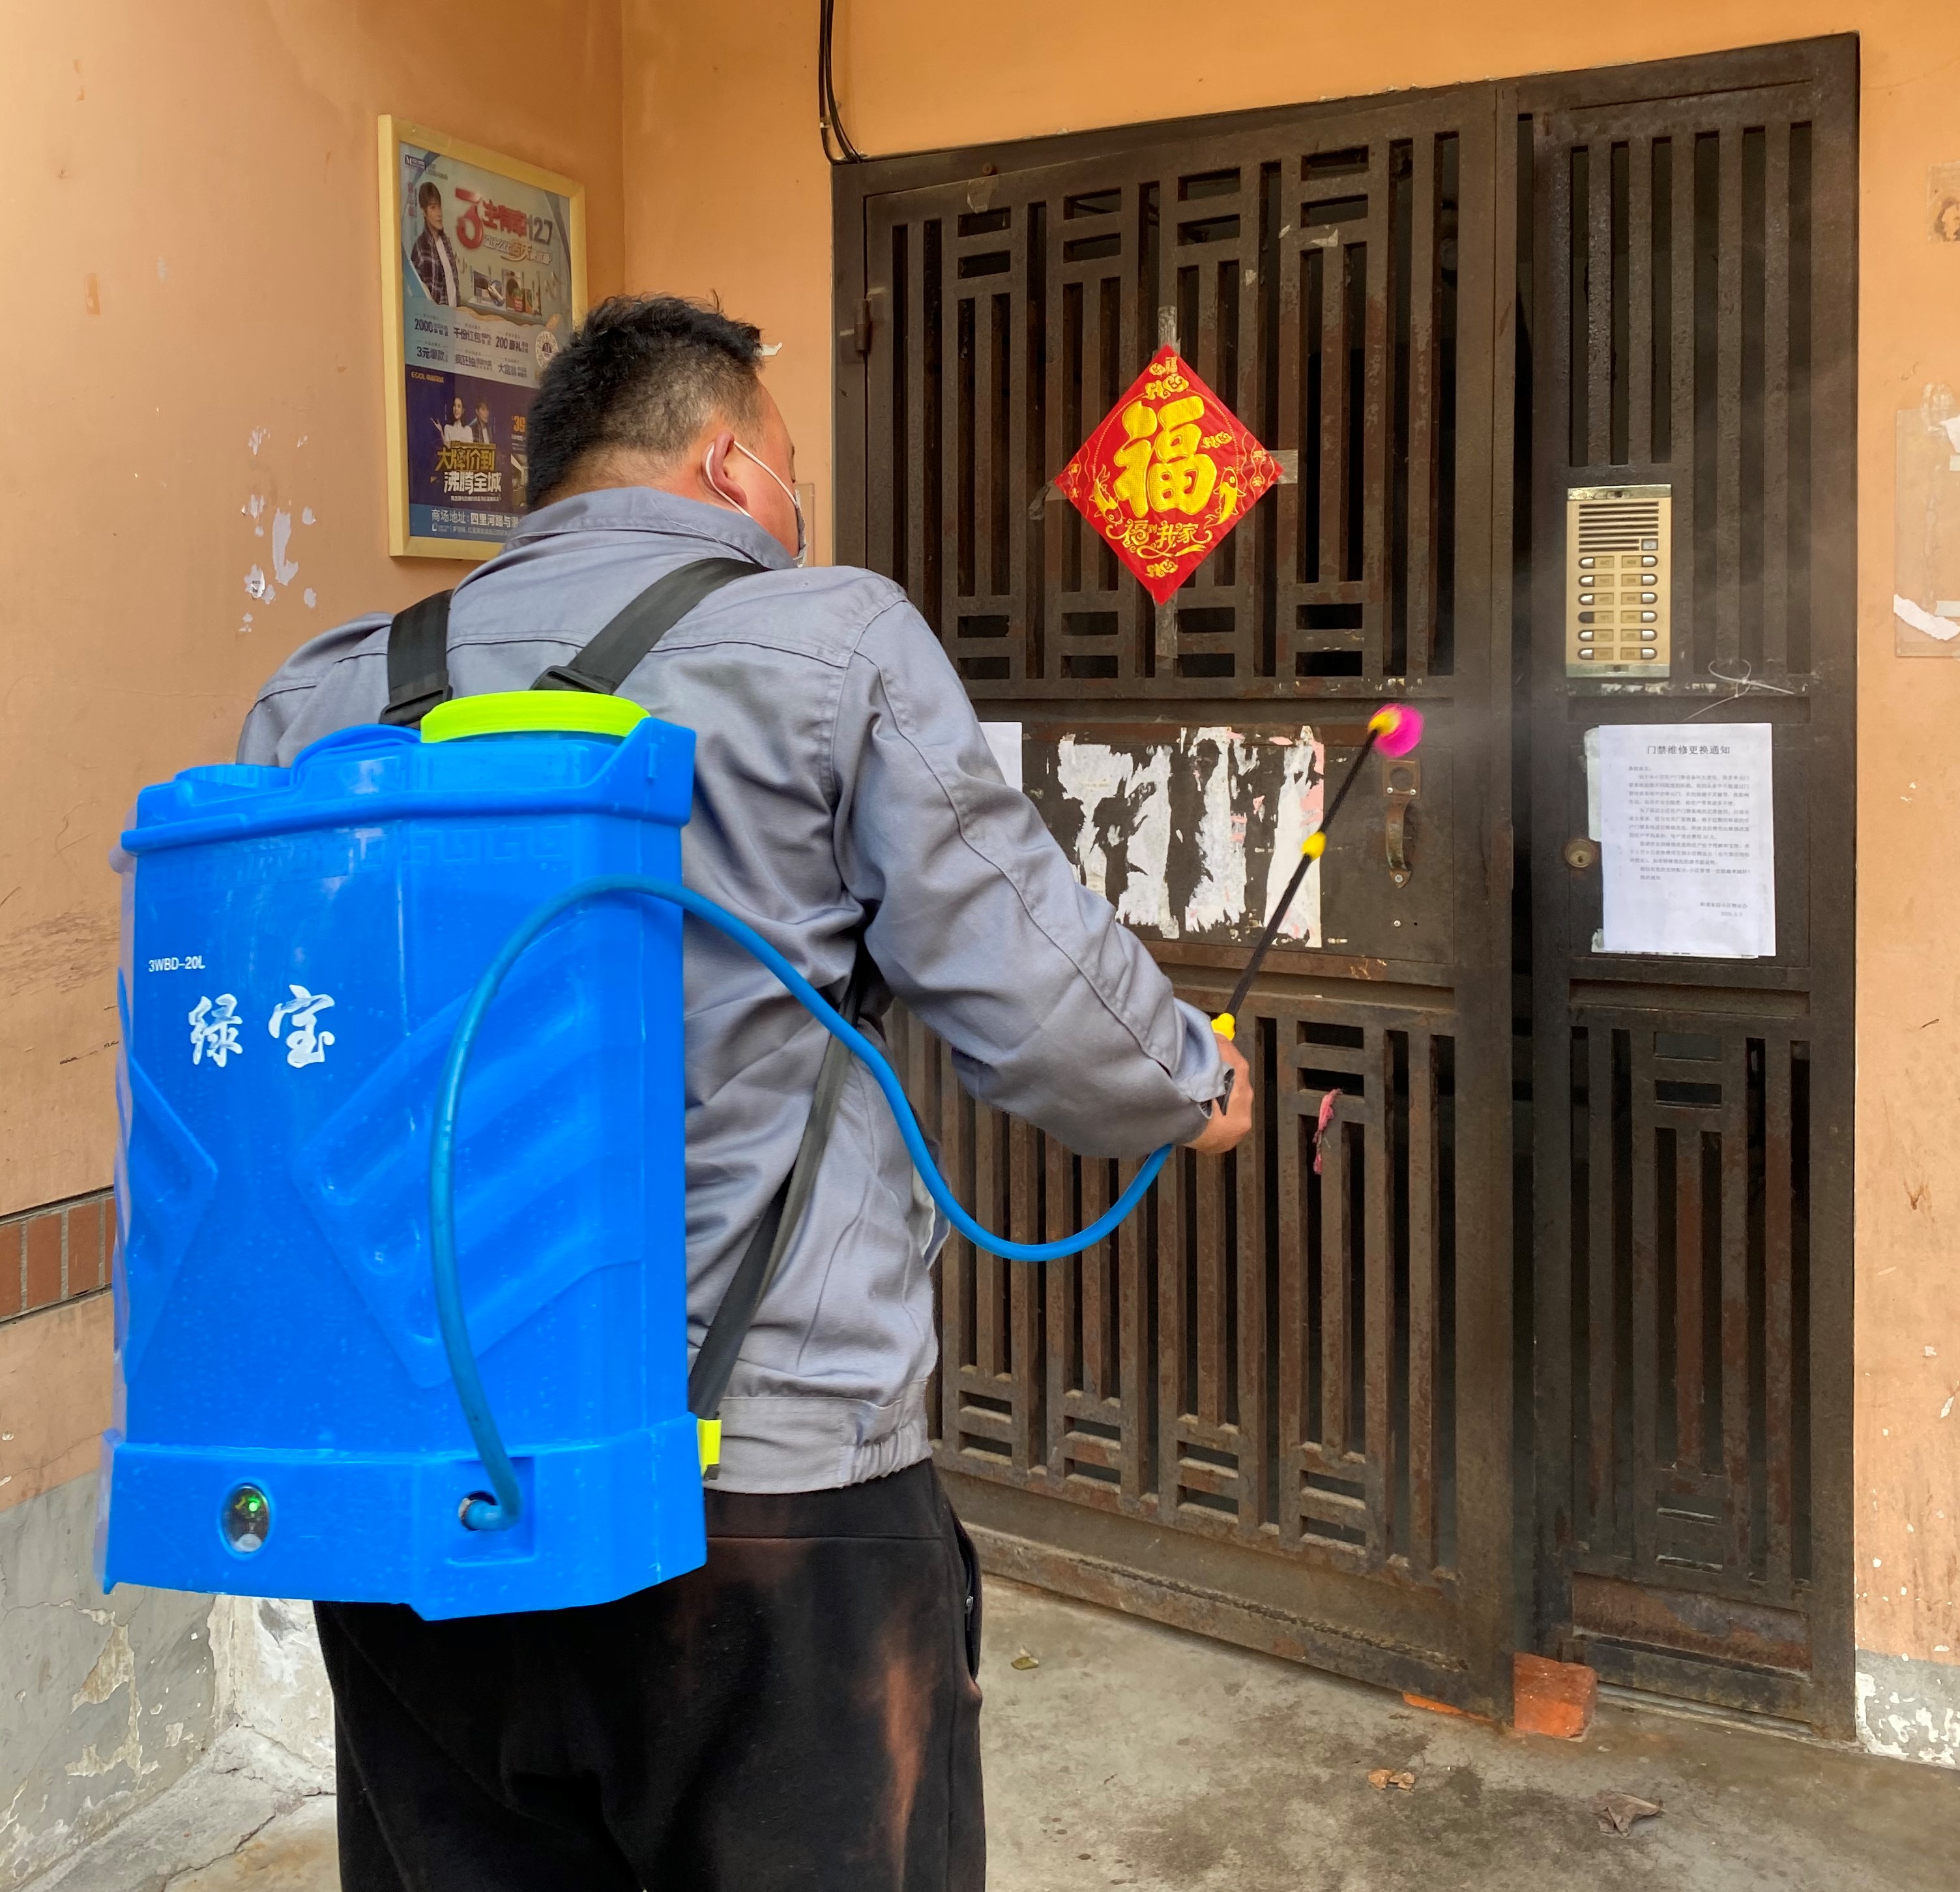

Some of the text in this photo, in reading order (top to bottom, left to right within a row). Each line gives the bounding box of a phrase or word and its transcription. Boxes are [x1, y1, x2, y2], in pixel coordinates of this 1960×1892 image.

[1113, 395, 1218, 518] 福
[443, 471, 503, 495] 沸腾全城
[1646, 745, 1731, 756] 门禁维修更换通知
[148, 955, 206, 973] 3WBD-20L
[188, 983, 336, 1069] 绿宝
